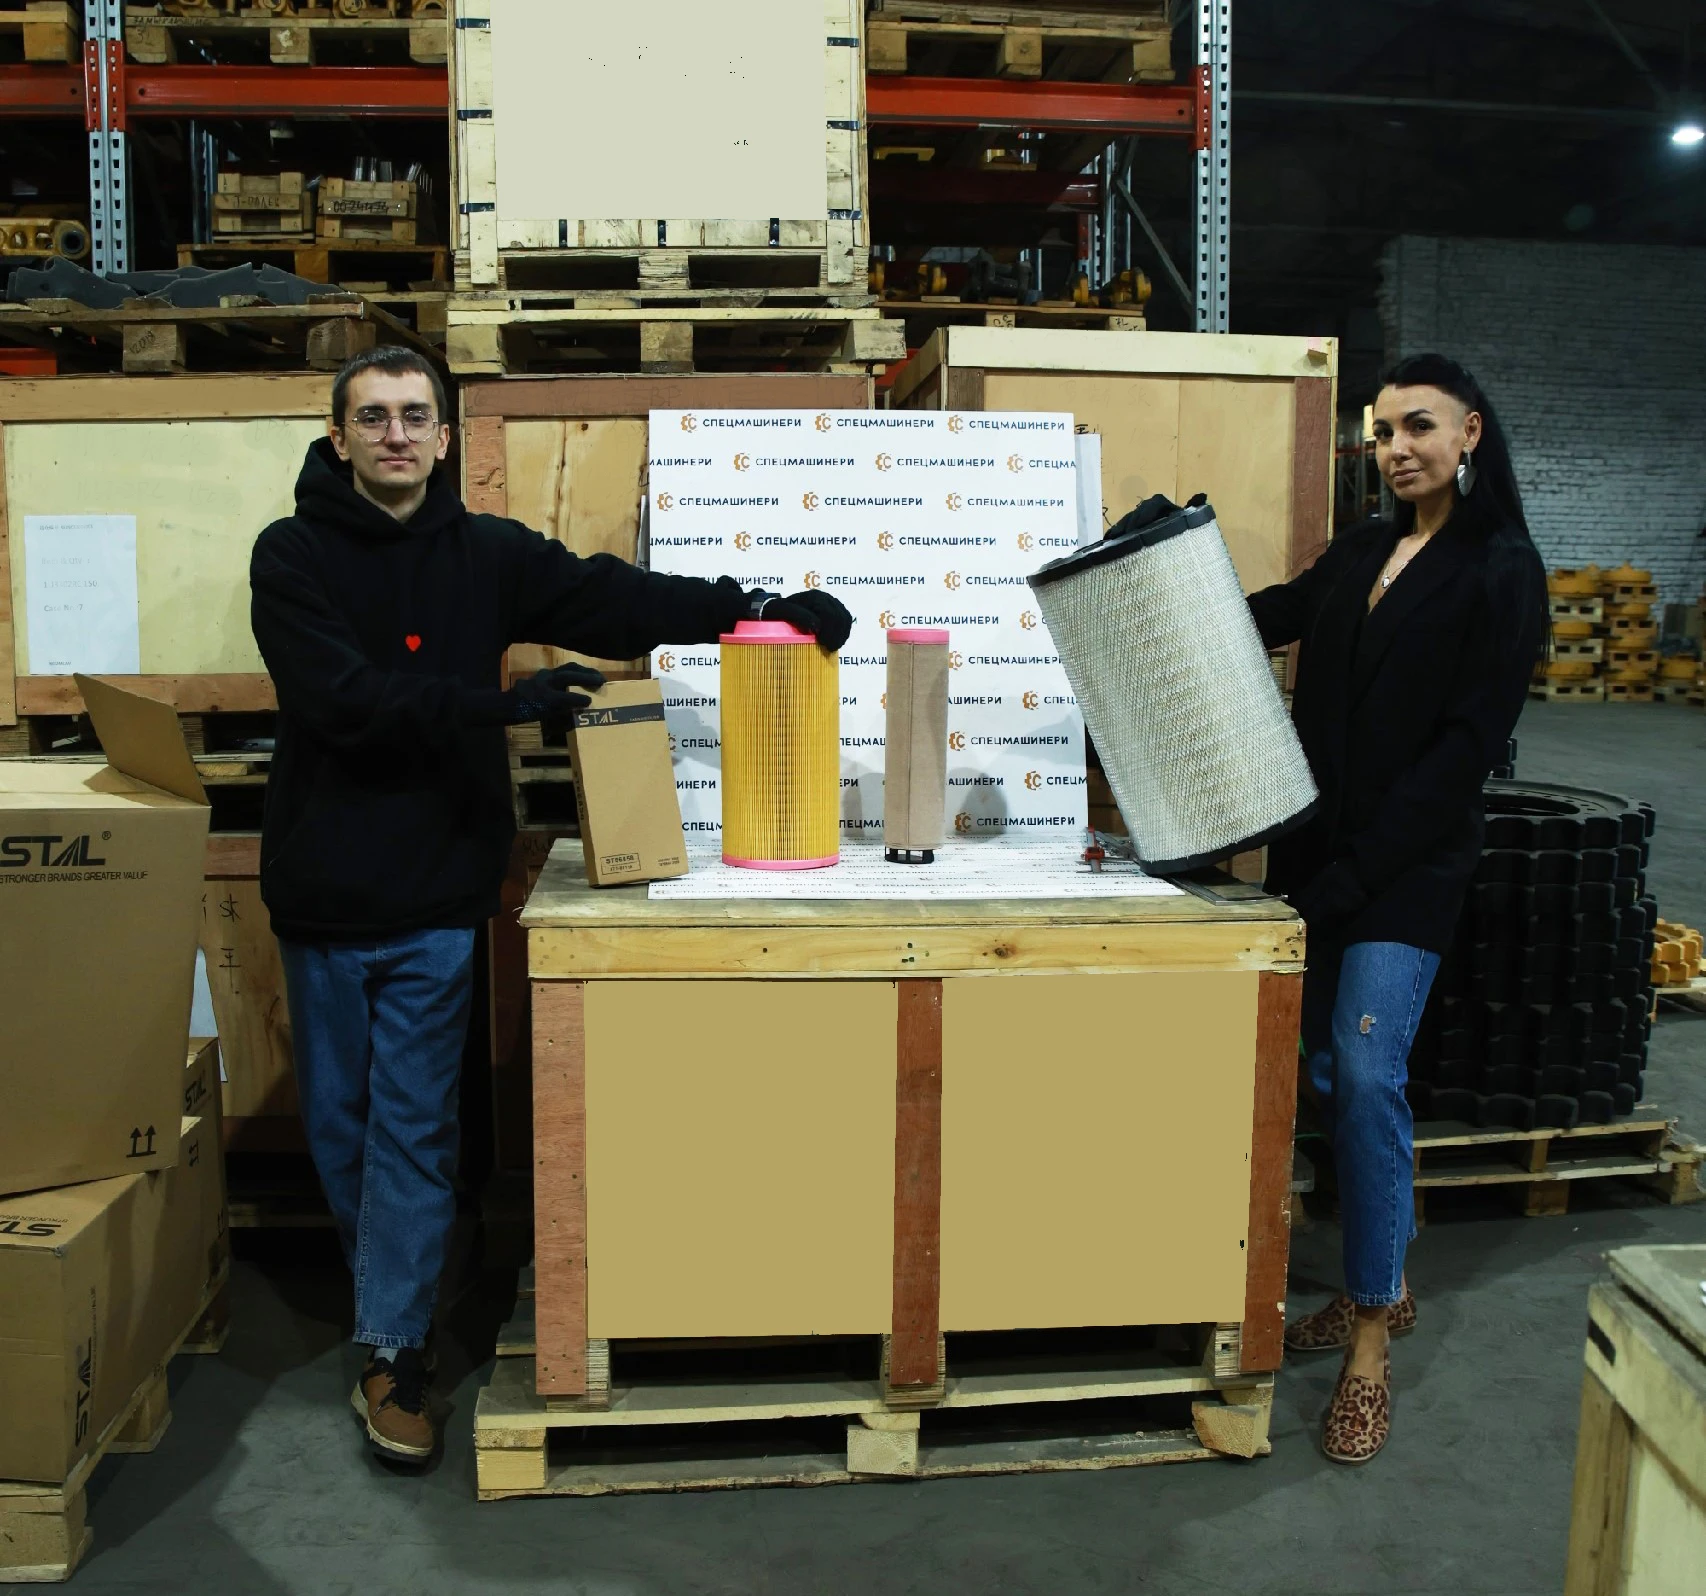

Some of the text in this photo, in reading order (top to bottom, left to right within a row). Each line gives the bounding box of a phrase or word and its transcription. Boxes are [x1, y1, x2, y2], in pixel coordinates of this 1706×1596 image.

[702, 418, 802, 428] СПЕЦМАШИНЕРИ
[836, 418, 934, 428] СПЕЦМАШИНЕРИ
[969, 420, 1065, 431] СПЕЦМАШИНЕРИ
[755, 458, 855, 467] СПЕЦМАШИНЕРИ
[896, 458, 994, 468] СПЕЦМАШИНЕРИ
[679, 497, 1064, 508] СПЕЦМАШИНЕРИ СПЕЦМАШИНЕРИ СПЕЦМАШИНЕРИ
[756, 536, 857, 546] СПЕЦМАШИНЕРИ
[898, 536, 997, 546] СПЕЦМАШИНЕРИ
[826, 576, 925, 586] СПЕЦМАШИНЕРИ
[900, 615, 1000, 626] СПЕЦМАШИНЕРИ
[968, 655, 1062, 666] СПЕЦМАШИНЕР
[1044, 695, 1077, 705] СПЕЦ
[578, 710, 619, 726] STAL
[970, 735, 1069, 746] СПЕЦМАШИНЕРИ
[976, 816, 1075, 827] СПЕЦМАШИНЕРИ
[0, 835, 106, 867] STAL
[0, 871, 149, 884] STRONGER BRANDS GREATER VALUE
[0, 1220, 62, 1237] ST
